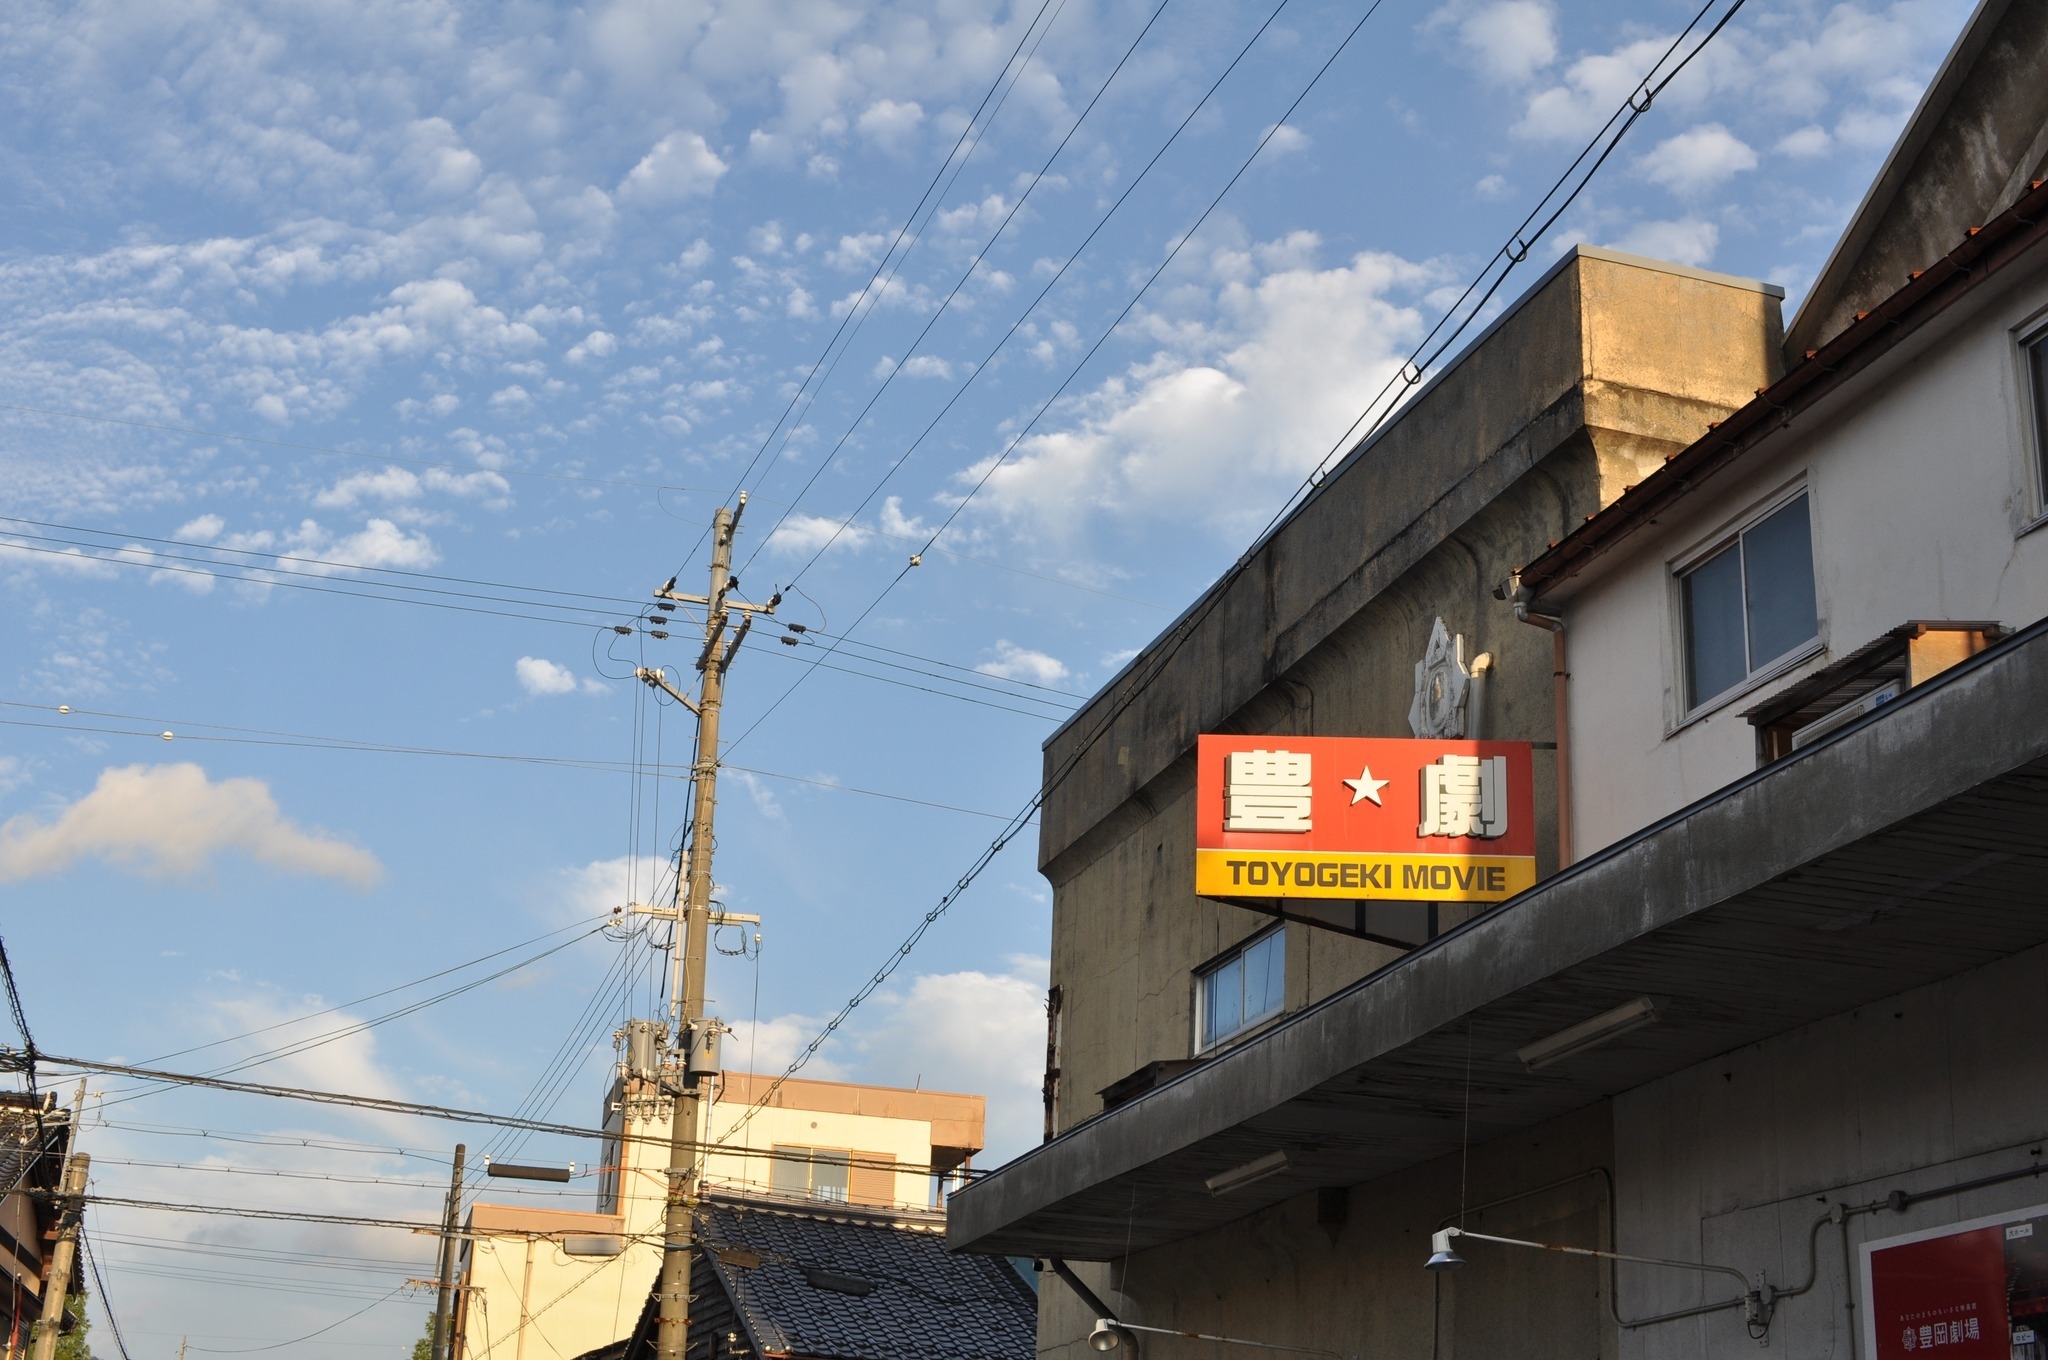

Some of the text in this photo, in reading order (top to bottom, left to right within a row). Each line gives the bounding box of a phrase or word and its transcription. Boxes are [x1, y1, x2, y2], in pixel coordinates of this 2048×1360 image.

[1226, 860, 1506, 892] TOYOGEKI MOVIE
[1919, 1317, 1980, 1349] 豊岡劇場
